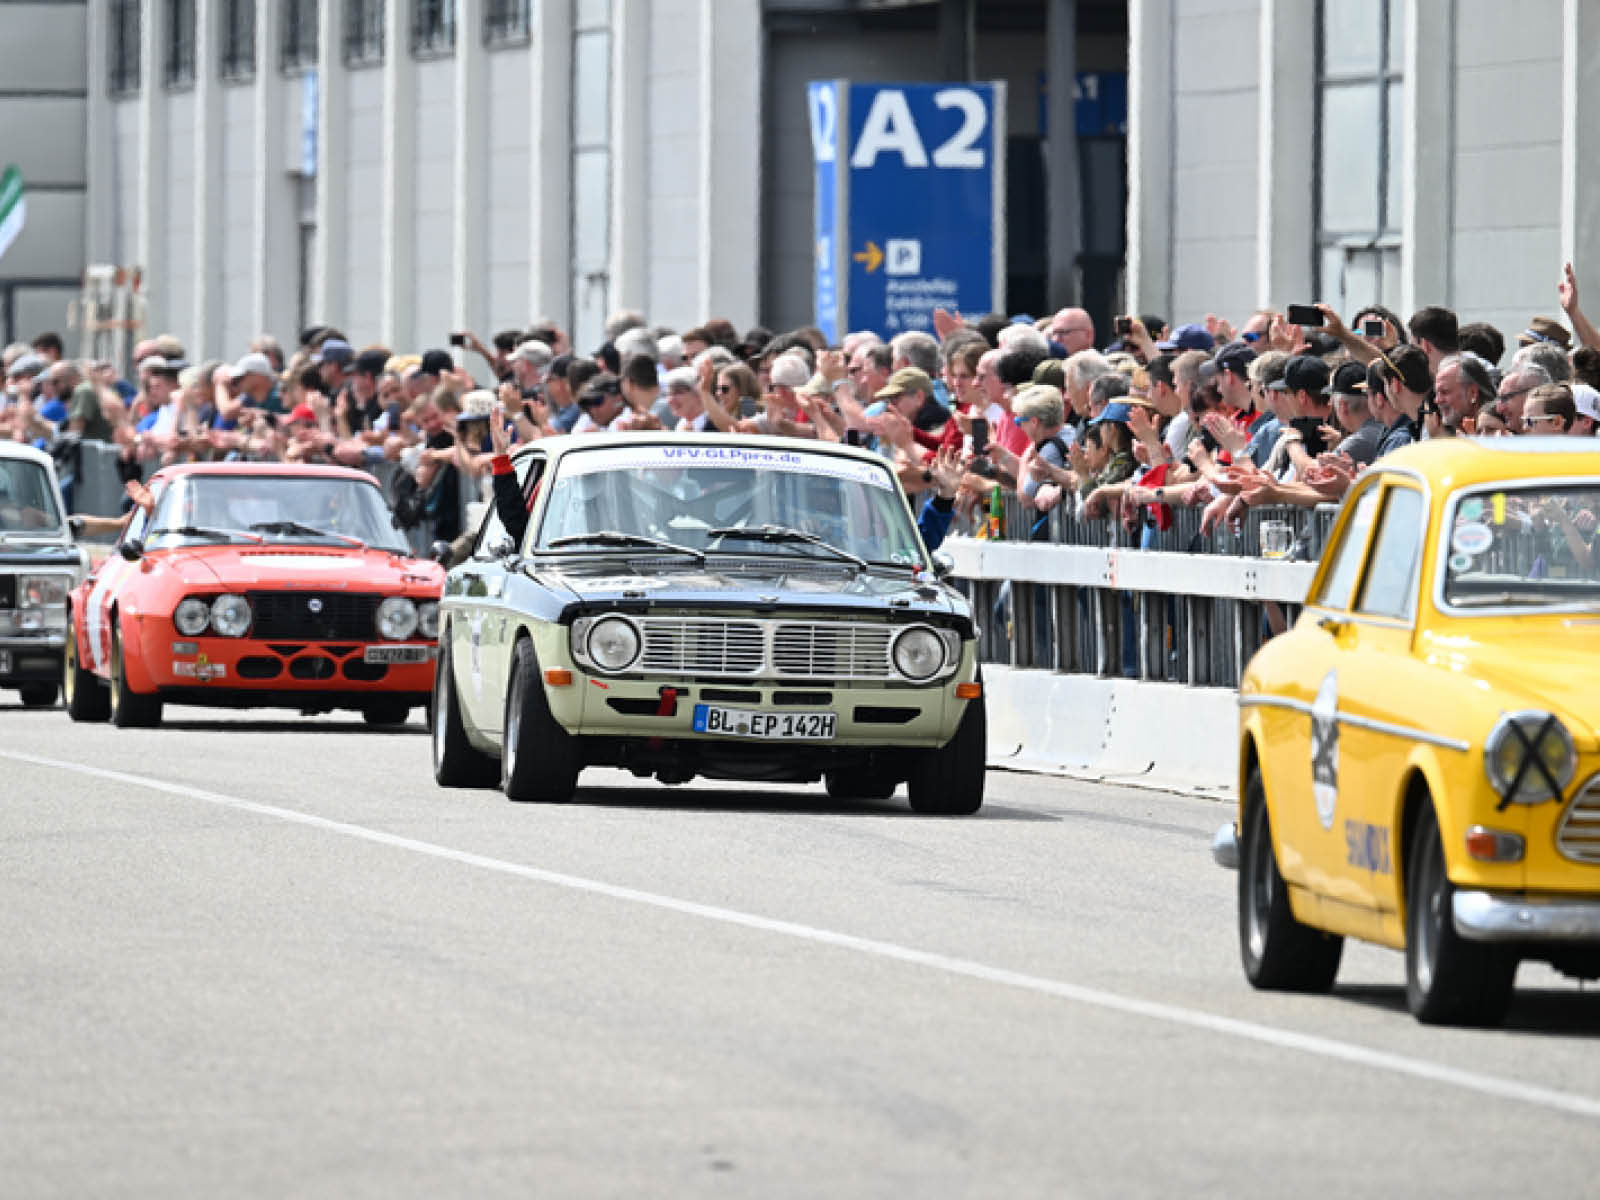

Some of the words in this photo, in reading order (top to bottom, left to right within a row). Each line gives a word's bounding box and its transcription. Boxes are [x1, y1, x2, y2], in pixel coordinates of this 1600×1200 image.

[851, 88, 987, 168] A2
[708, 709, 734, 732] BL
[750, 715, 777, 735] EP
[782, 715, 835, 737] 142H
